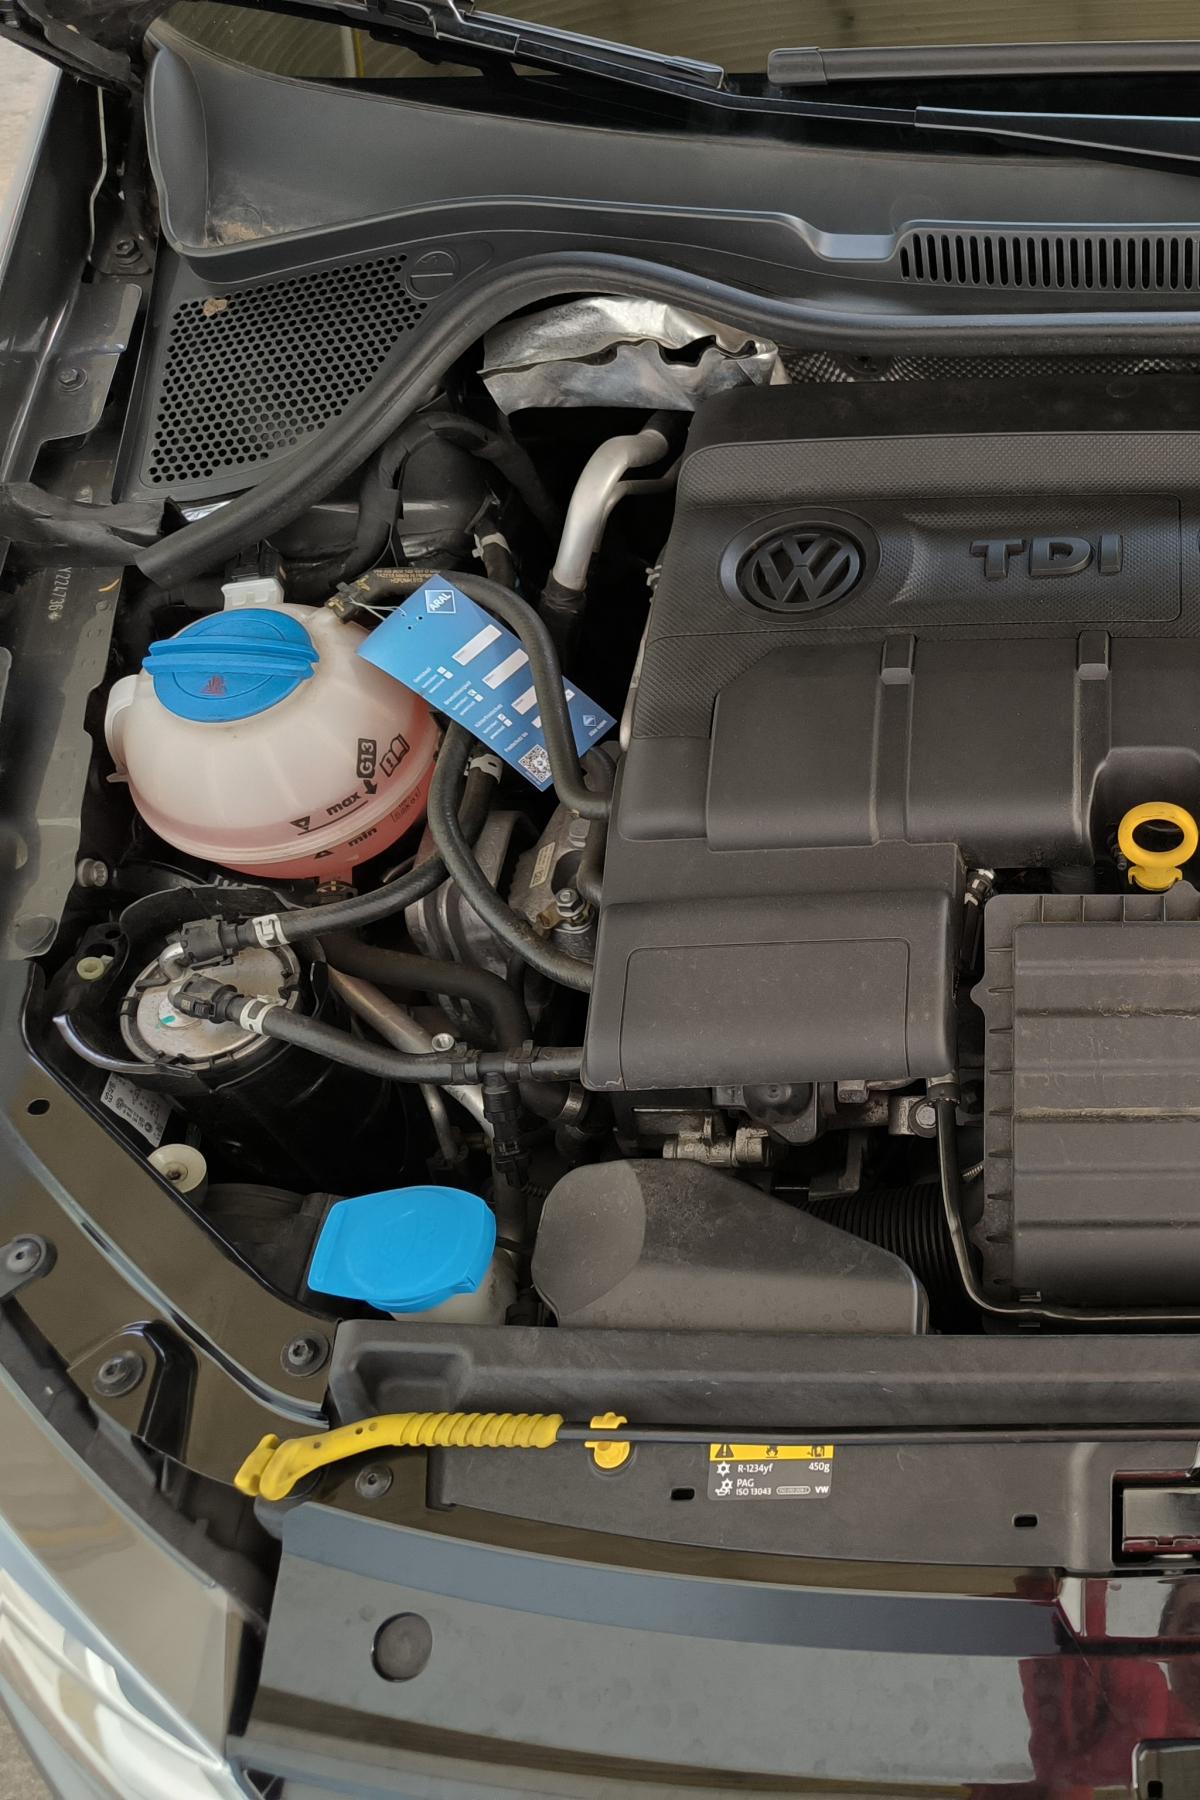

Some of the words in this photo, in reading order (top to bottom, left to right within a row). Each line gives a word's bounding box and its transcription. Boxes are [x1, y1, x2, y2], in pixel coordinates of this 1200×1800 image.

[968, 533, 1125, 578] TDI
[429, 593, 452, 611] ARAL
[359, 742, 374, 775] G13
[326, 792, 362, 816] max
[348, 828, 378, 847] min
[738, 1463, 773, 1475] R-1234yf
[808, 1461, 830, 1472] 450g
[736, 1479, 754, 1487] PAG
[750, 1487, 772, 1495] 13043
